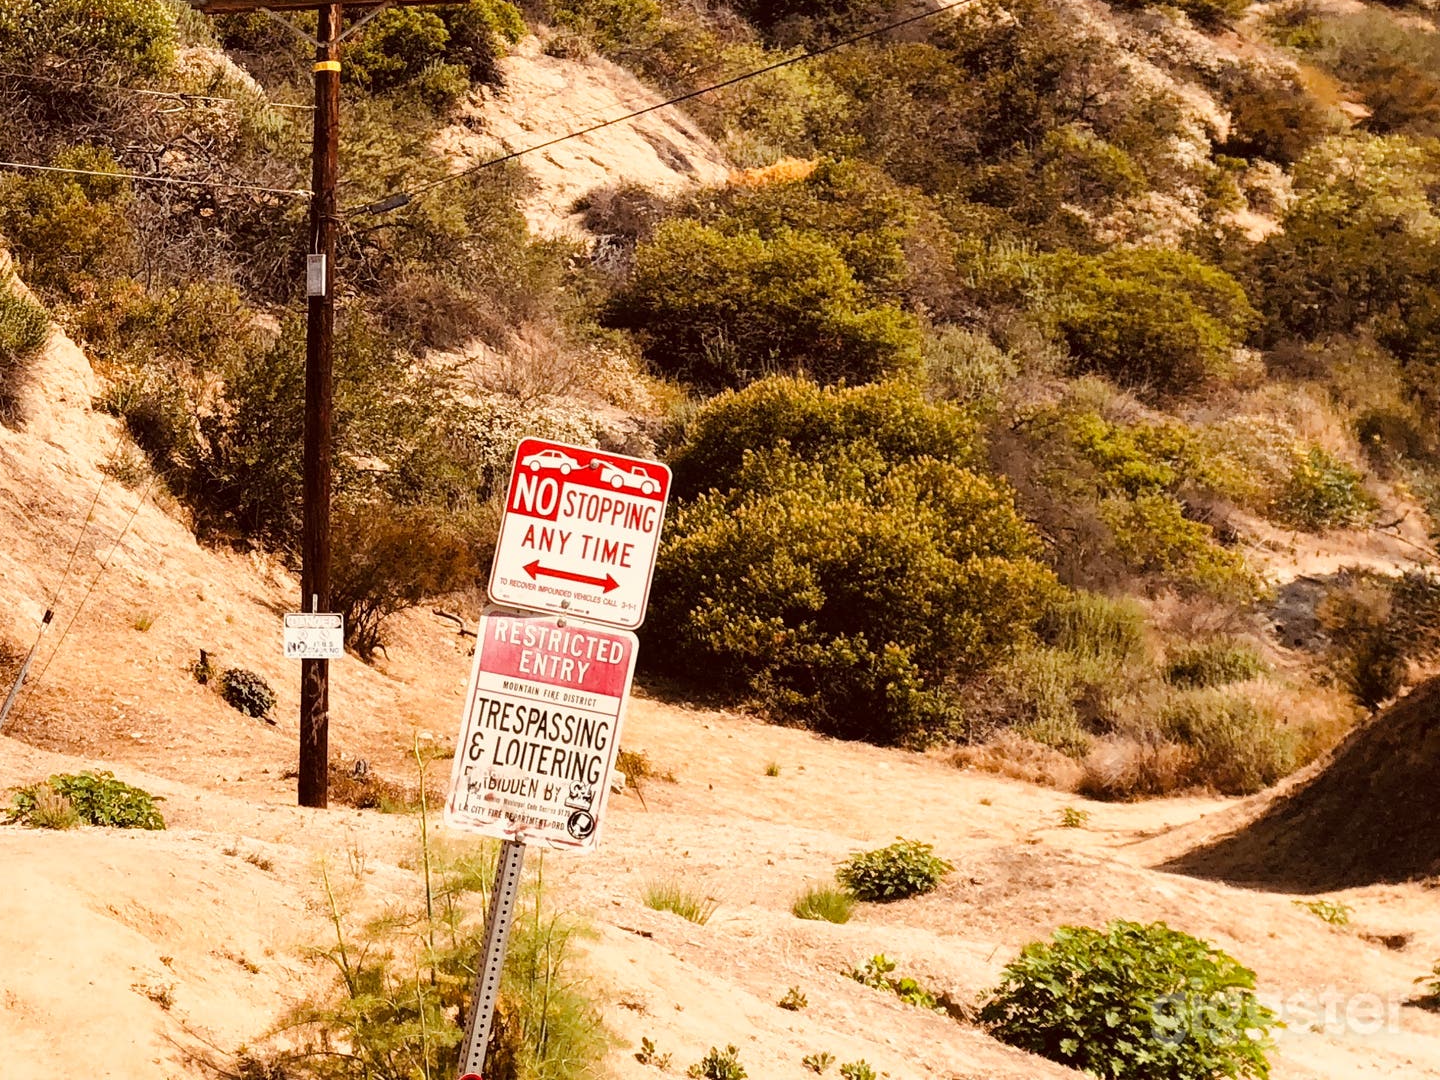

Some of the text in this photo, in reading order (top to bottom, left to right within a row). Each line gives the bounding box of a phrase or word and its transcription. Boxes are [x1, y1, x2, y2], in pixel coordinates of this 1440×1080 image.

[513, 472, 656, 533] NO STOPPING
[521, 524, 634, 568] ANY TIME
[510, 580, 536, 591] RECOVER
[538, 585, 572, 598] IMPOUNDED
[574, 591, 601, 604] VEHICLES
[603, 598, 617, 607] CALL
[287, 640, 308, 653] NO
[495, 619, 624, 665] RESTRICTED
[519, 650, 590, 684] ENTRY
[503, 681, 597, 707] MOUNTAIN FIRE DISTRICT
[476, 697, 608, 751] TRESPASSING
[468, 732, 602, 785] & LOITERING
[471, 806, 485, 815] CITY
[488, 808, 502, 819] FIRE
